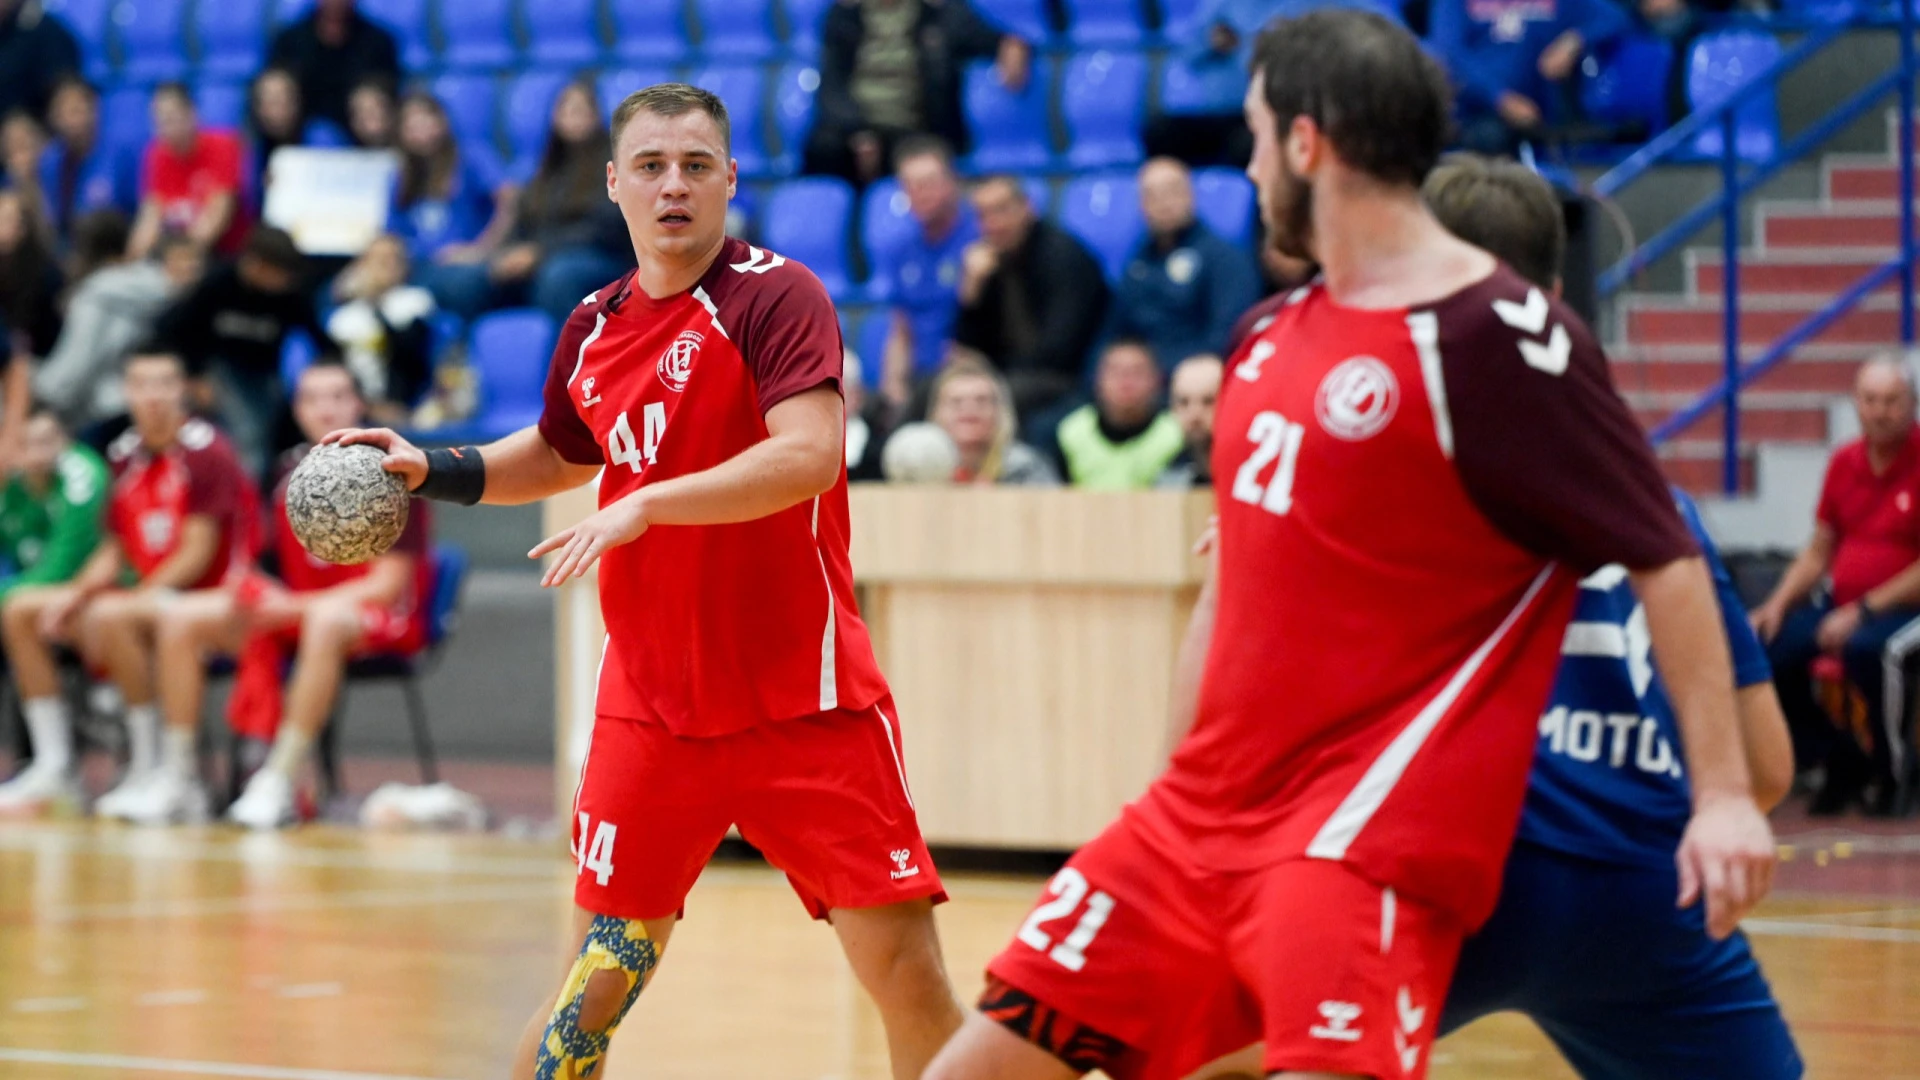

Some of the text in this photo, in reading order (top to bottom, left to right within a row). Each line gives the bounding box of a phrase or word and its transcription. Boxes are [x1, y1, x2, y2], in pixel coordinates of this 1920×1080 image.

[608, 401, 667, 475] 44
[1231, 410, 1305, 517] 21
[1537, 704, 1683, 779] MOTO
[1016, 866, 1116, 973] 21
